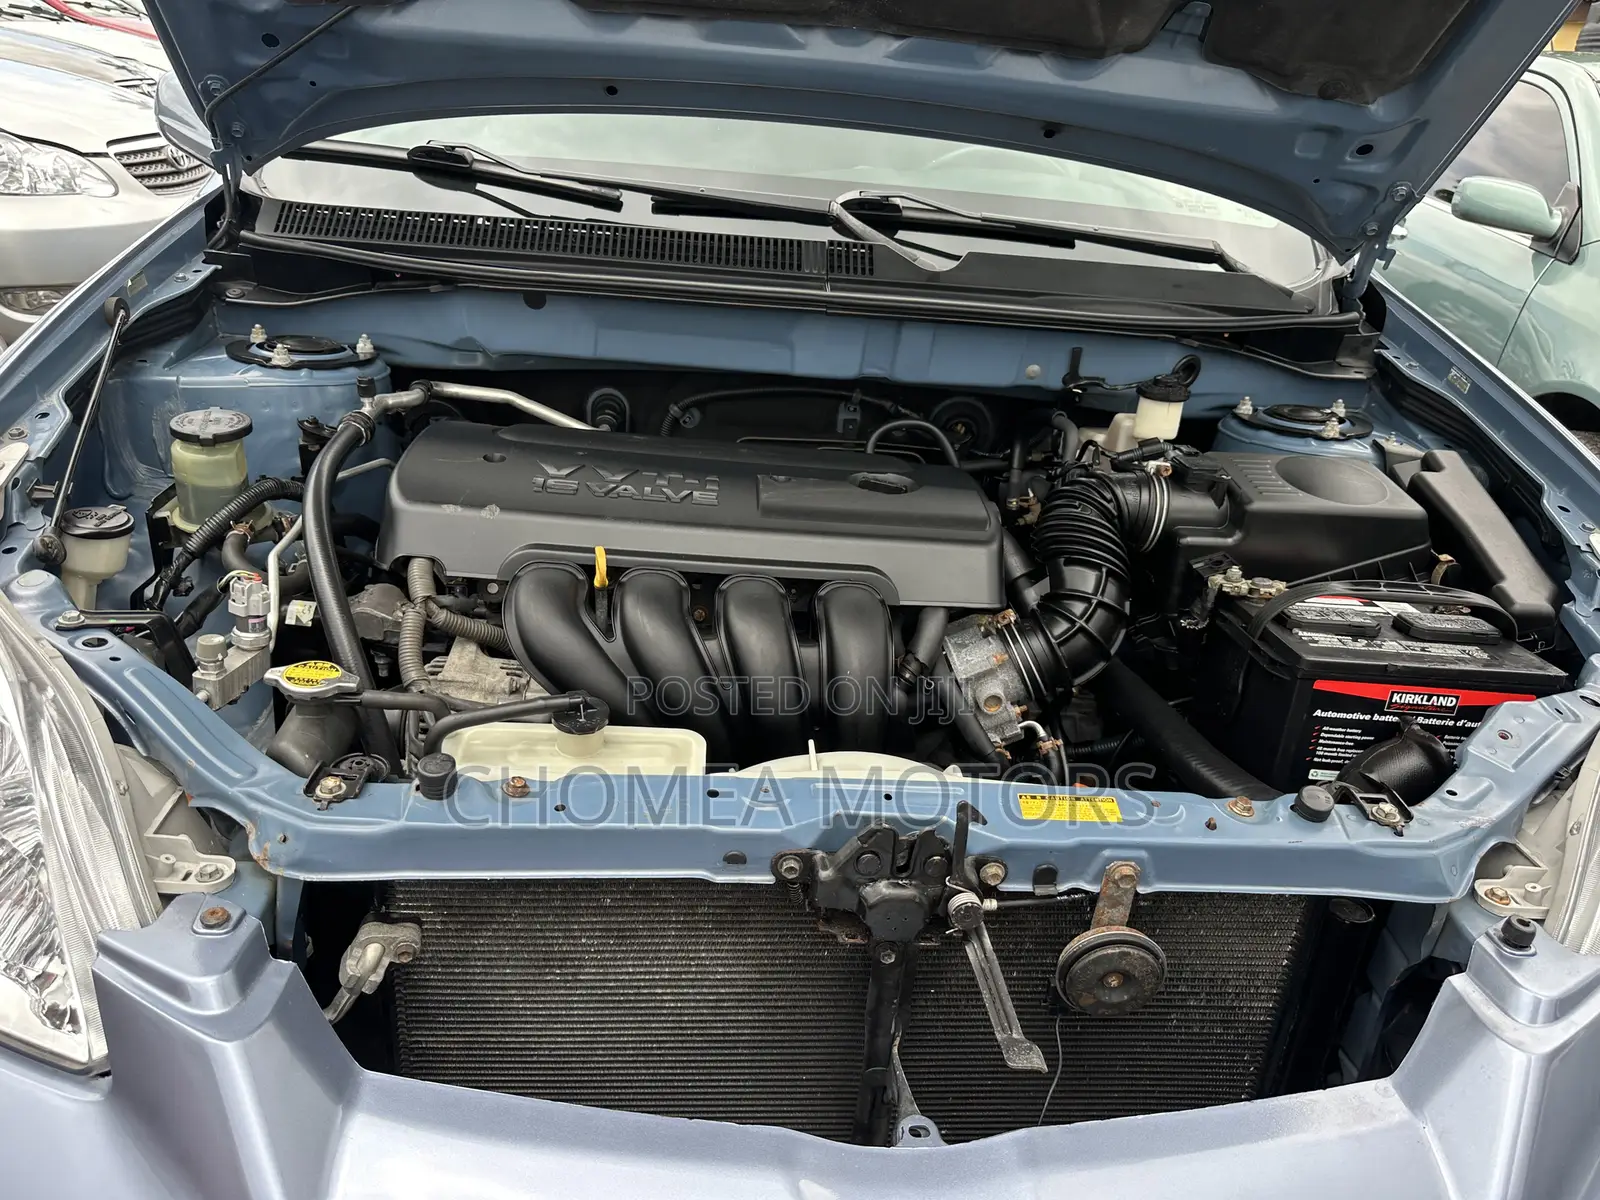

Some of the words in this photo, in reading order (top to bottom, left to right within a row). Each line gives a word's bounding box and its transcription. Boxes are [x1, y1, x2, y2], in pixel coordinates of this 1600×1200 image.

[532, 477, 579, 495] 16
[585, 480, 719, 506] VALVE
[1391, 692, 1457, 707] KIRKLAND
[1390, 703, 1454, 713] Signature
[1313, 709, 1372, 721] Automotive
[1373, 713, 1399, 722] batte
[1416, 716, 1455, 727] Batterie
